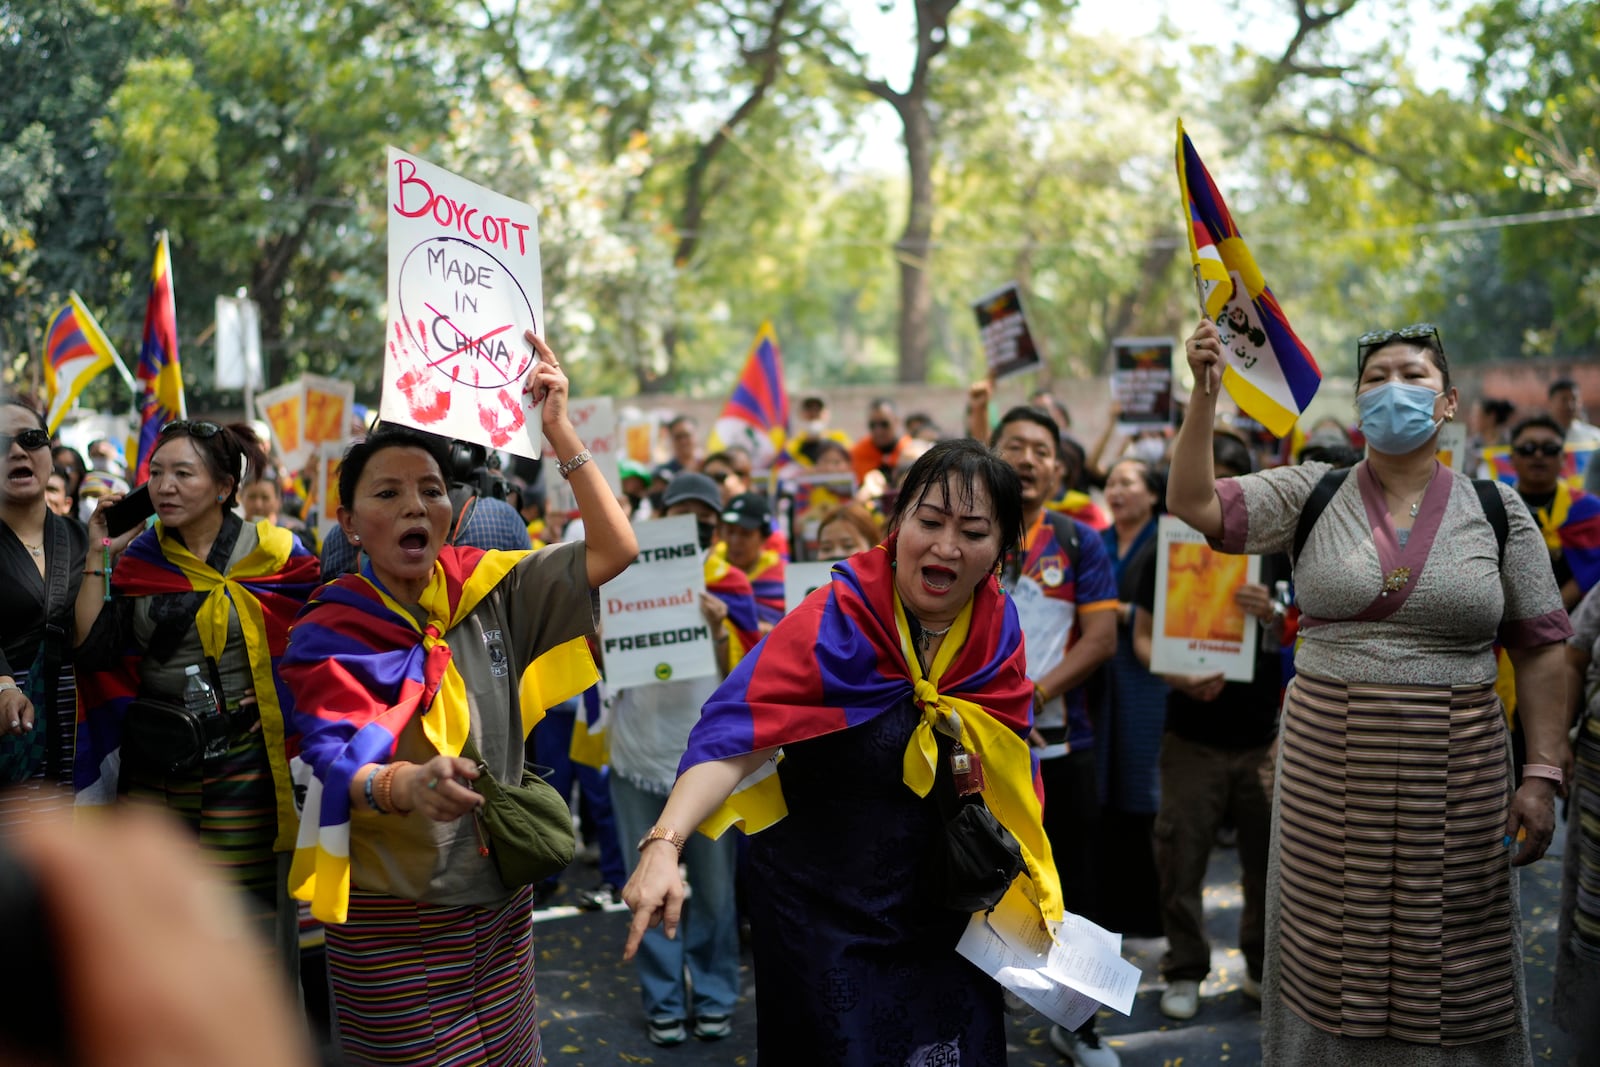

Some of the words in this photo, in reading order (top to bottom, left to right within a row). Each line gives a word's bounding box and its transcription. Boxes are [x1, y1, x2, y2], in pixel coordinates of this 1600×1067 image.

[394, 159, 530, 256] BOYCOTT
[427, 247, 494, 290] MADE
[455, 290, 478, 314] IN
[431, 314, 511, 365] CHINA
[607, 588, 694, 615] Demand
[605, 625, 709, 654] FREEDOM
